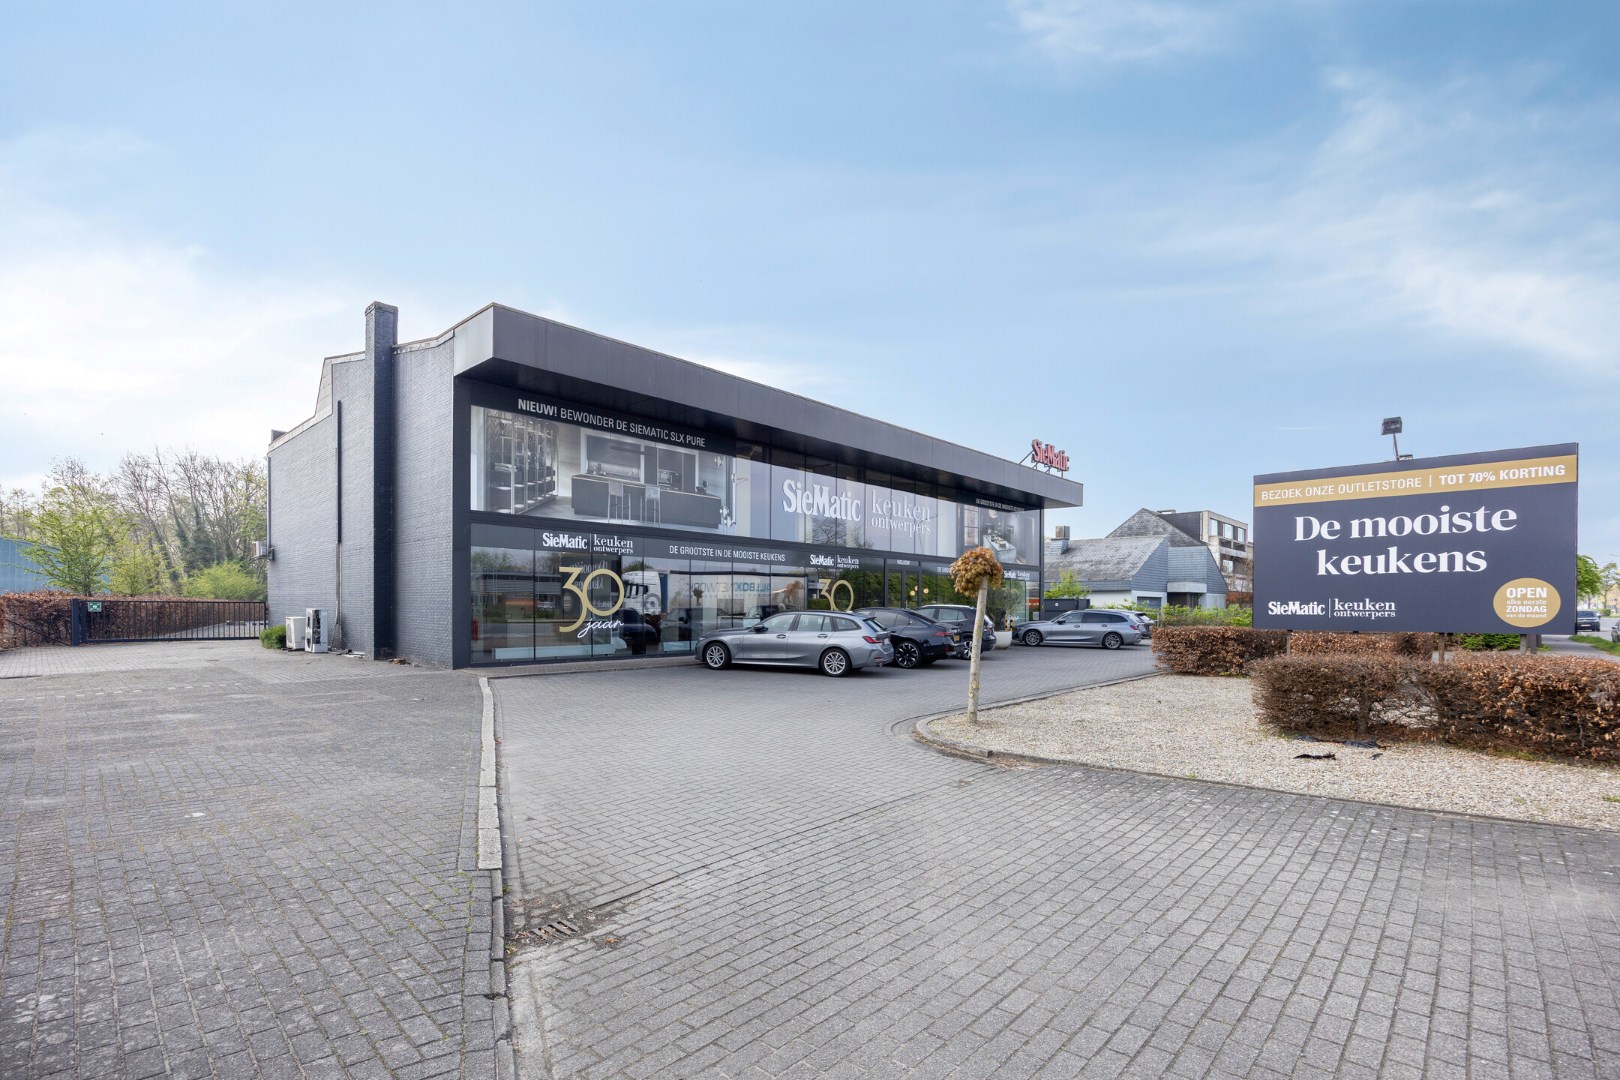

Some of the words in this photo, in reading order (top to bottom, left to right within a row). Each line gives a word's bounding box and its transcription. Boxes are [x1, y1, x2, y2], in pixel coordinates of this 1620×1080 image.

[518, 399, 557, 417] NIEUW!
[560, 408, 614, 428] BEWONDER
[616, 420, 628, 431] DE
[629, 423, 669, 440] SIEMATIC
[670, 431, 684, 443] SLX
[686, 435, 705, 447] PURE
[1031, 439, 1069, 472] SieMatic
[1438, 473, 1465, 485] TOT
[1468, 471, 1496, 483] 70%
[1499, 464, 1565, 480] KORTING
[1261, 487, 1302, 501] BEZOEK
[1305, 484, 1335, 497] ONZE
[1337, 477, 1422, 494] OUTLETSTORE
[782, 479, 861, 521] SieMatic
[872, 489, 931, 521] keuken
[871, 516, 931, 537] ontwerpers
[1294, 515, 1341, 542] De
[1349, 504, 1518, 540] mooiste
[542, 532, 588, 549] SieMatic
[593, 534, 633, 548] keuken
[593, 546, 634, 555] ontwerpers
[669, 545, 679, 554] DE
[680, 546, 714, 557] GROOTSTE
[715, 549, 722, 557] IN
[723, 549, 732, 558] DE
[733, 550, 759, 560] MOOISTE
[760, 552, 786, 562] KEUKENS
[810, 554, 834, 566] SieMatic
[1316, 545, 1488, 576] keukens
[559, 566, 625, 633] 30
[818, 578, 854, 612] 30
[1506, 587, 1547, 598] OPEN
[1268, 601, 1325, 615] SieMatic
[1333, 598, 1396, 611] keuken
[1333, 609, 1396, 620] ontwerpers
[1505, 605, 1547, 613] ZONDAG
[577, 618, 624, 639] jaar
